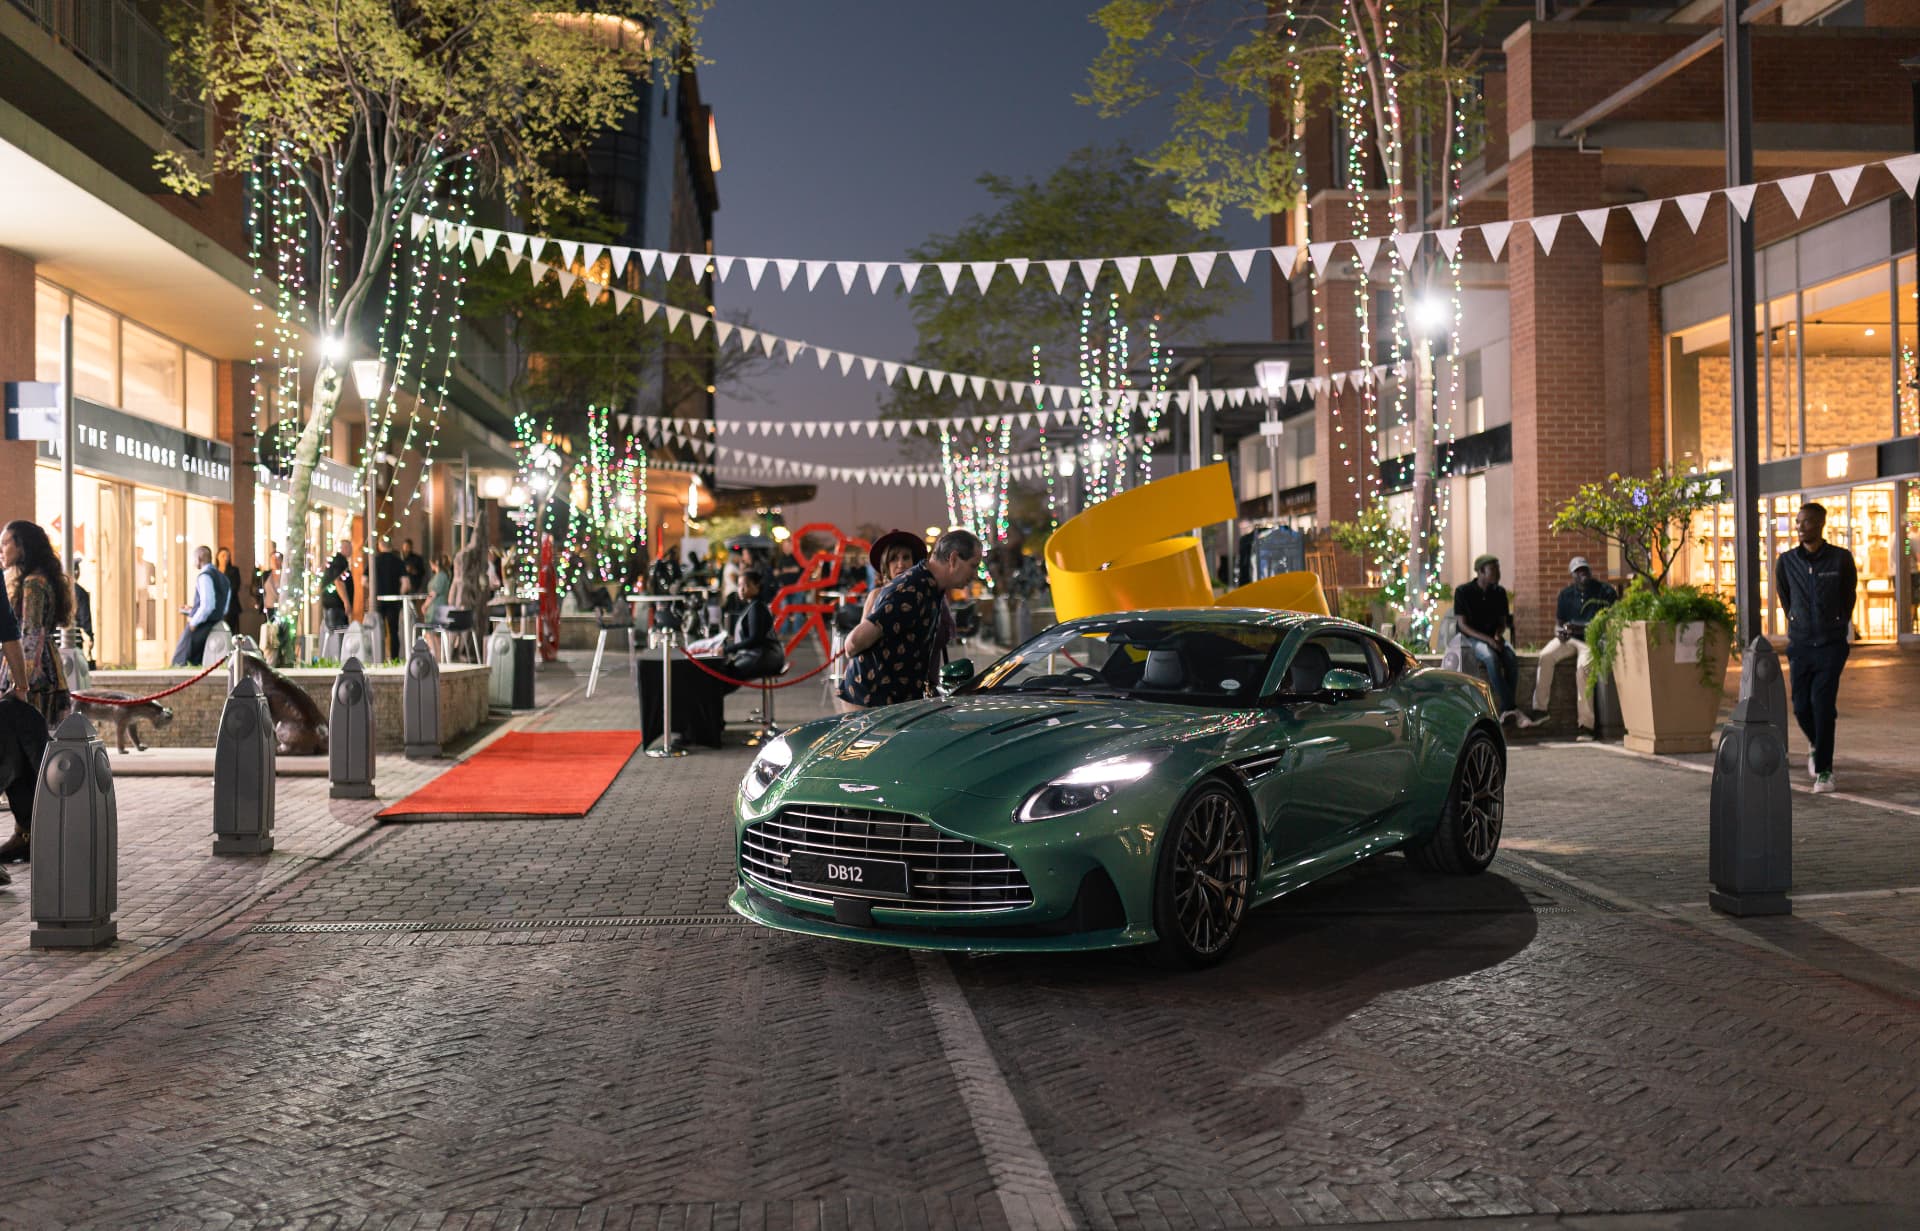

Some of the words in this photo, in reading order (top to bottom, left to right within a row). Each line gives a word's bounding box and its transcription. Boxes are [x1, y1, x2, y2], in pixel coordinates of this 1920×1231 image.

[78, 424, 107, 450] THE
[115, 434, 176, 468] MELROSE
[828, 863, 863, 882] DB12
